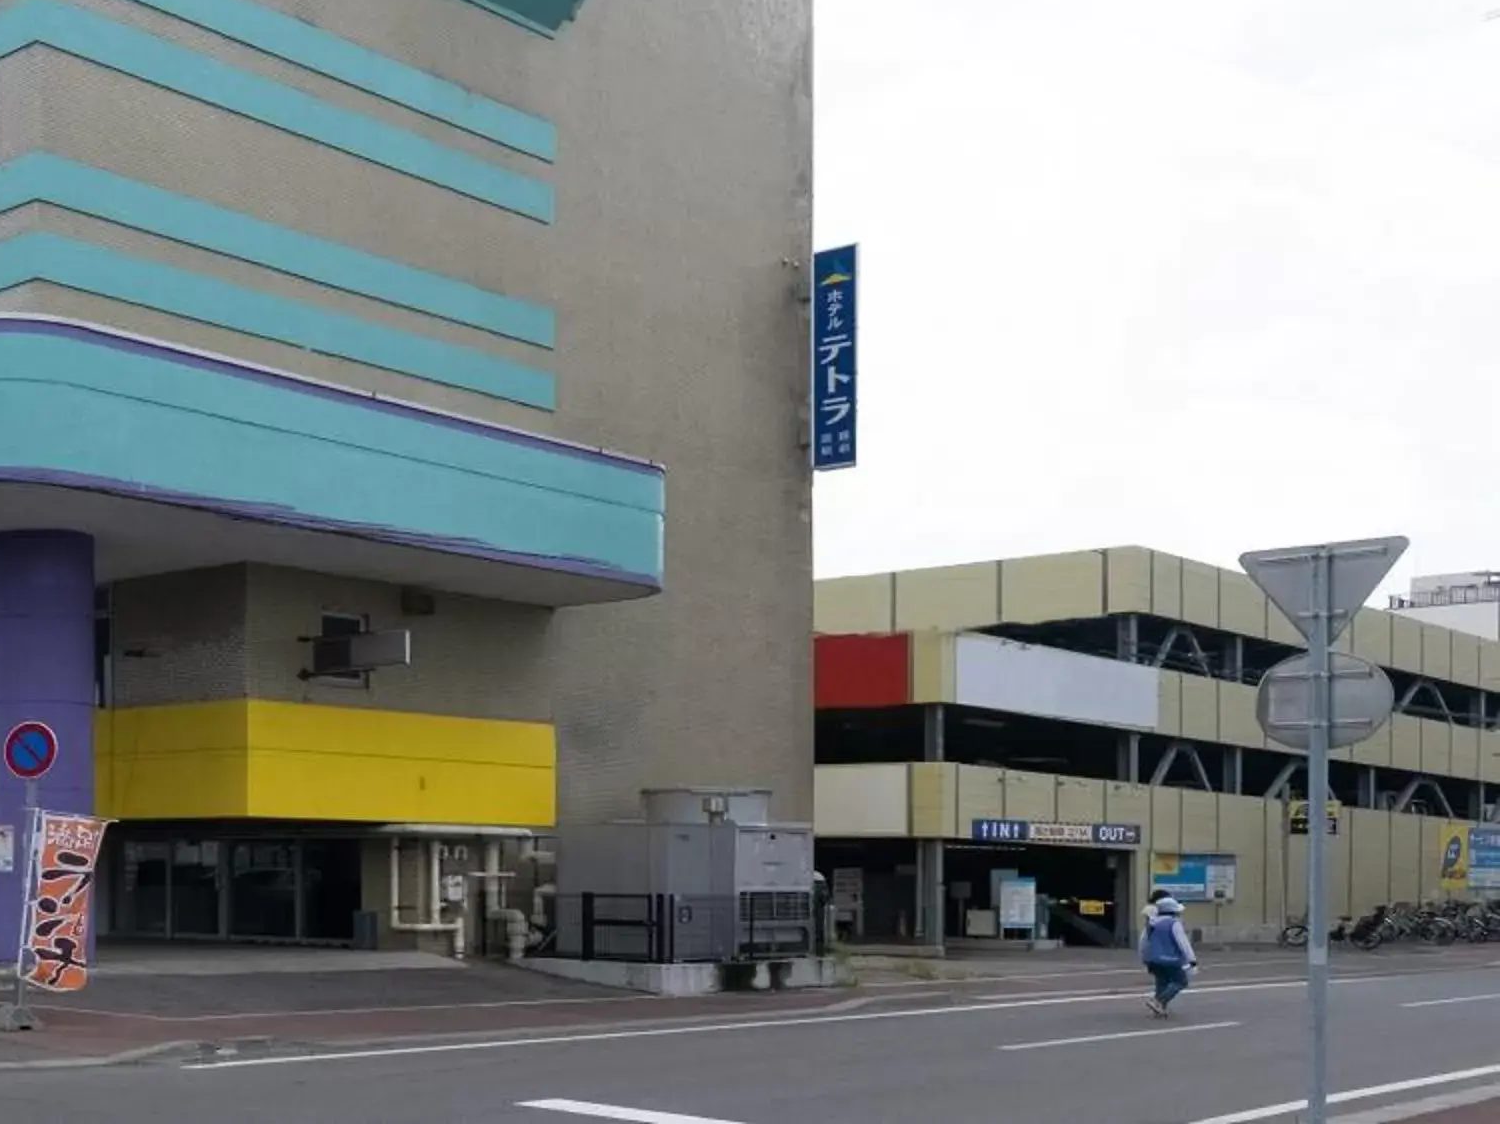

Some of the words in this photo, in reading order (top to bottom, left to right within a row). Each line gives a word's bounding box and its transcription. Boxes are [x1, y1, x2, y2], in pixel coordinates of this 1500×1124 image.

[827, 290, 844, 331] ホテル
[818, 334, 852, 425] テトラ
[992, 822, 1011, 838] IN
[1099, 826, 1125, 841] OUT
[34, 850, 92, 987] ランチ
